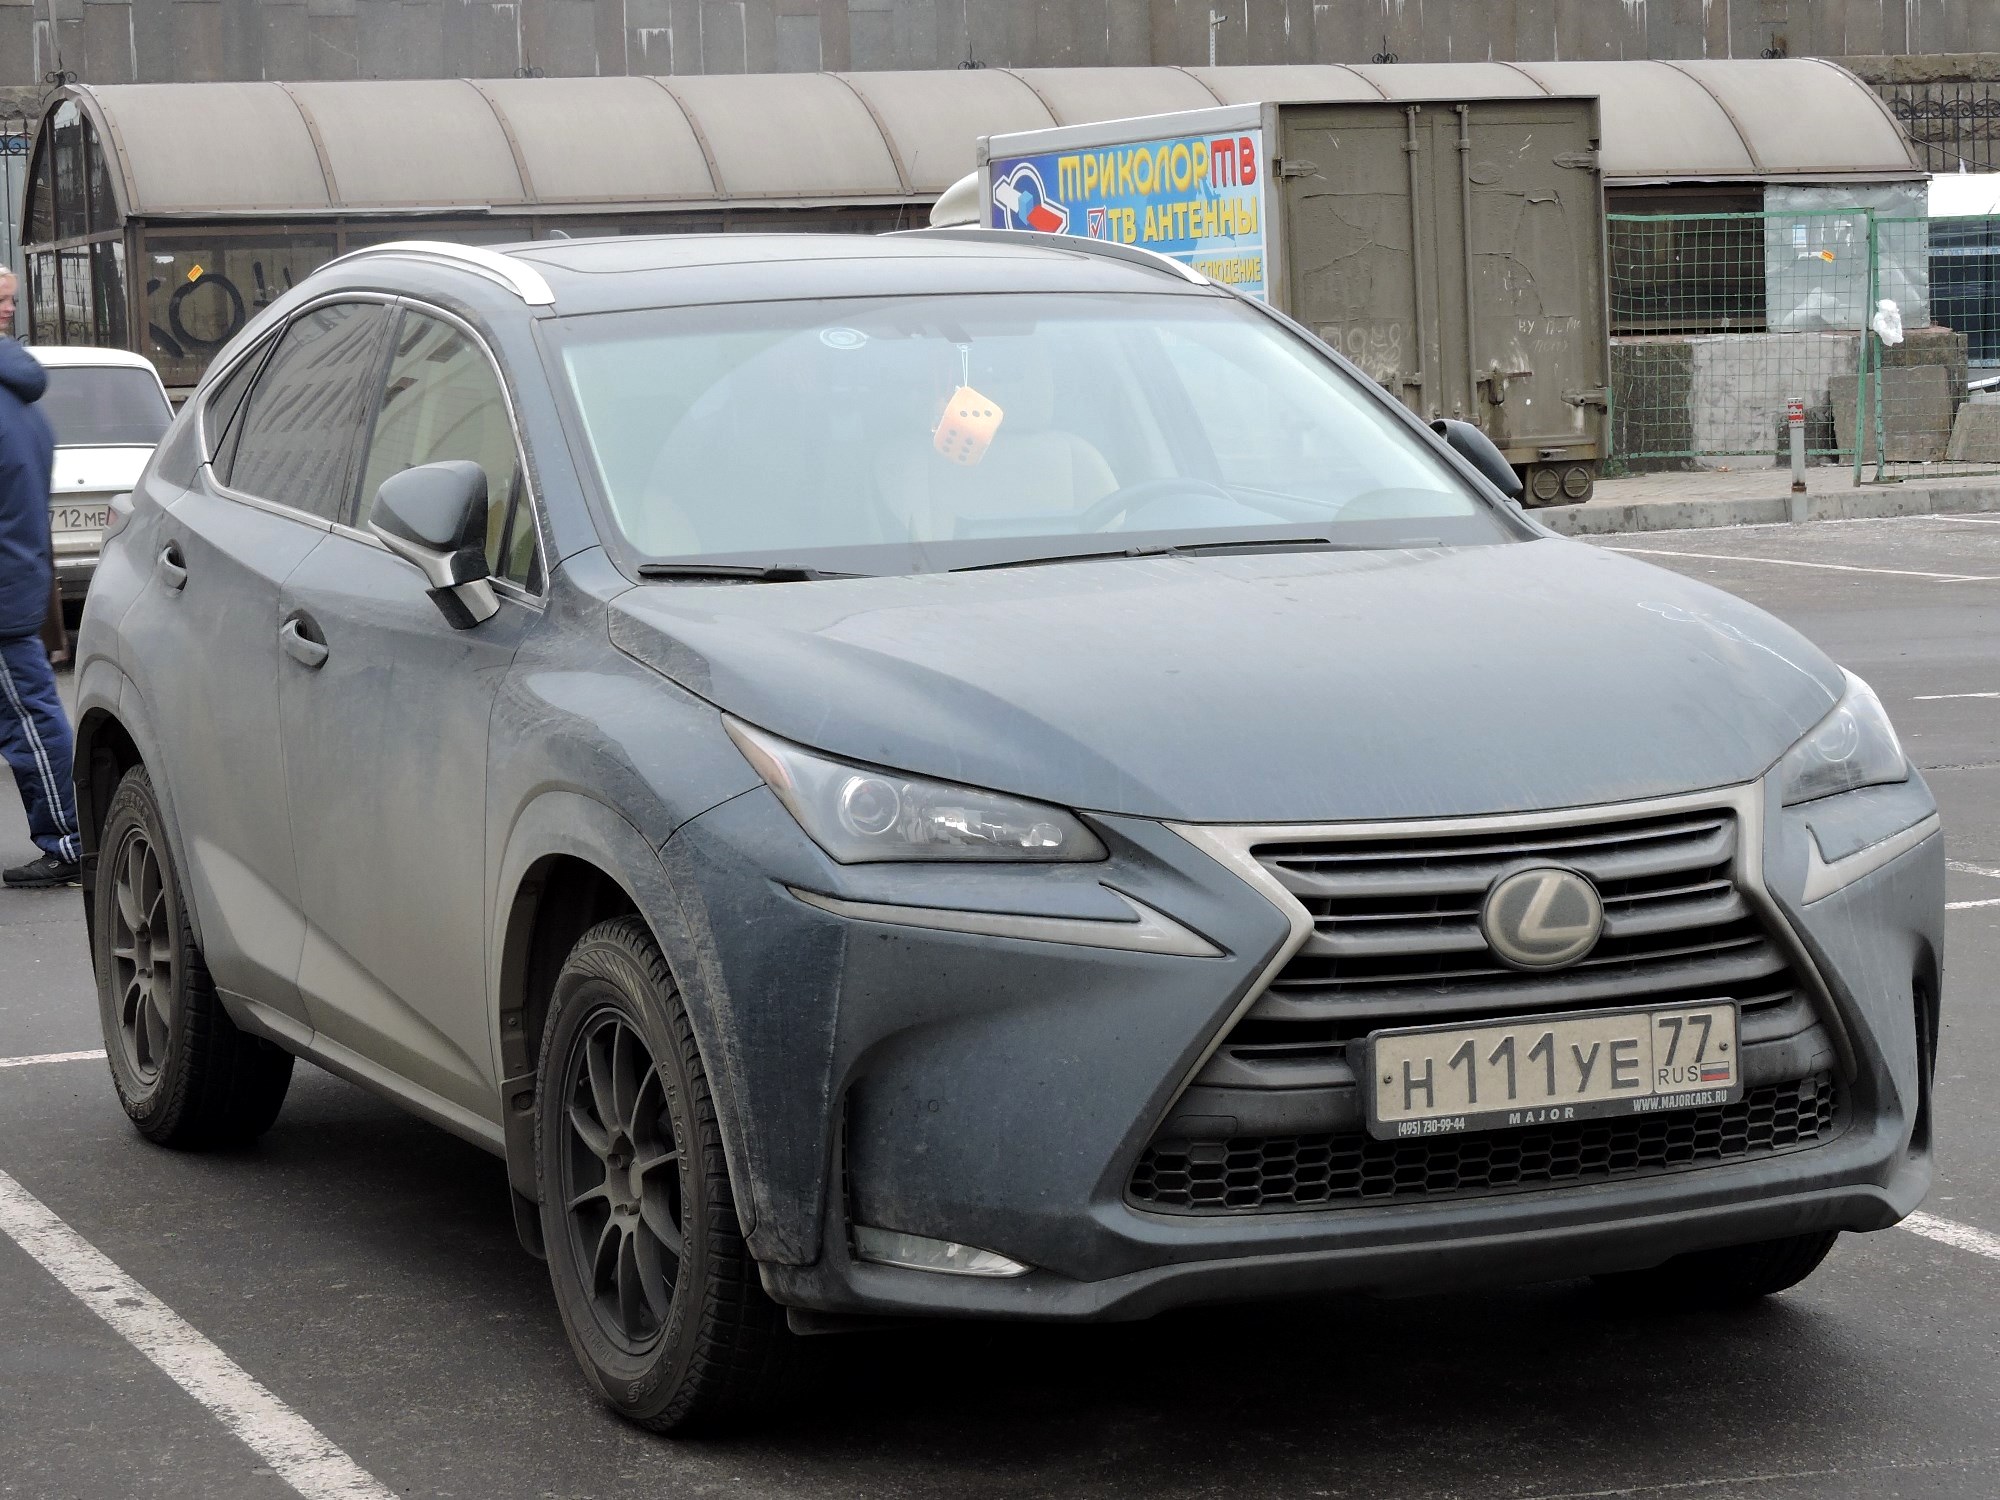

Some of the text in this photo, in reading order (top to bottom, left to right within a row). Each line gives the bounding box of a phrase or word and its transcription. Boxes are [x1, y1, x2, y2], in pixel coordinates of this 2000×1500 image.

[1108, 197, 1258, 243] ТВ АНТЕННЫ
[1659, 1014, 1712, 1067] 77
[1658, 1065, 1699, 1085] RUS
[1633, 1089, 1728, 1112] WWW.MAJORCARS.RU
[1509, 1107, 1575, 1125] MAJOR
[1398, 1117, 1466, 1137] (495) 730-99-44
